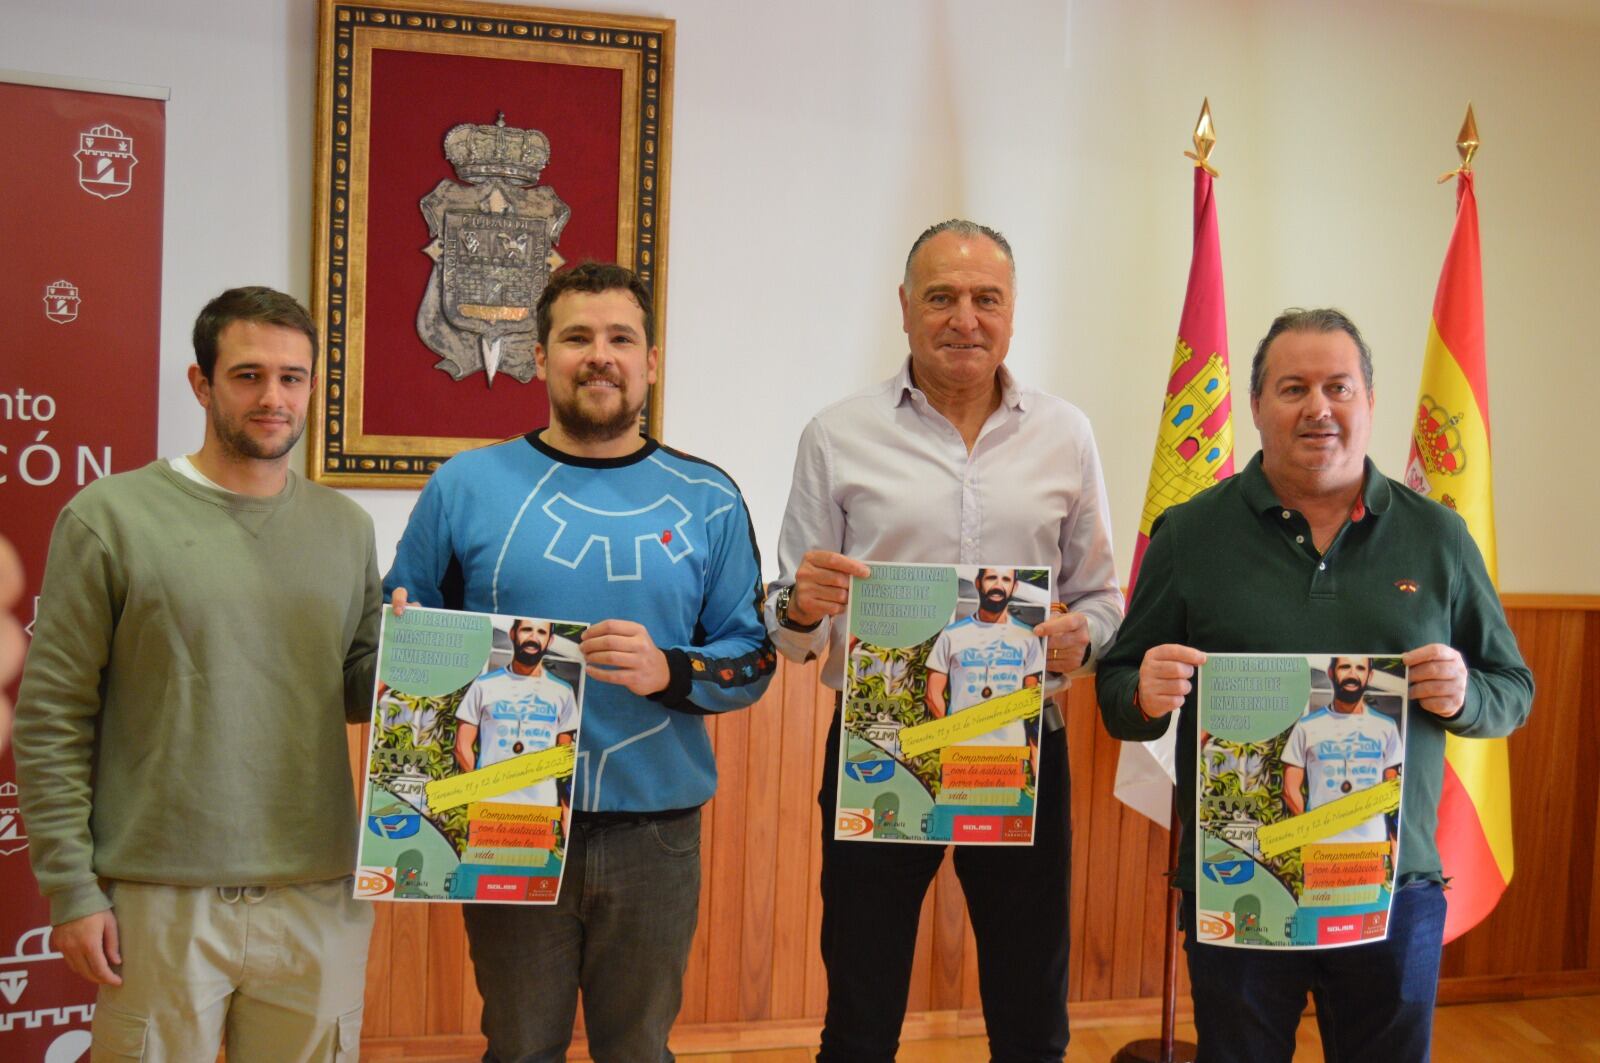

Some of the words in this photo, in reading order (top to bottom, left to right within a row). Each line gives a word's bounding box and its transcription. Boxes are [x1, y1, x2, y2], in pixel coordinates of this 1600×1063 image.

[0, 388, 57, 421] nto
[889, 567, 949, 582] REGIONAL
[913, 585, 930, 600] DE
[860, 601, 920, 619] INVIERNO
[921, 605, 937, 619] DE
[423, 612, 484, 631] REGIONAL
[447, 632, 464, 648] DE
[391, 647, 451, 667] INVIERNO
[453, 652, 469, 669] DE
[952, 752, 1018, 764] Comprometidos
[950, 767, 966, 775] con
[968, 765, 978, 774] la
[948, 779, 972, 789] para
[974, 778, 993, 787] toda
[995, 779, 1005, 787] la
[948, 791, 968, 801] vida
[480, 808, 548, 823] Comprometidos
[479, 825, 494, 833] con
[496, 823, 506, 833] la
[475, 839, 499, 848] para
[501, 838, 521, 847] toda
[523, 839, 534, 847] la
[474, 850, 495, 860] vida
[1313, 849, 1379, 862] Comprometidos
[1313, 866, 1329, 874] con
[1331, 863, 1340, 874] la
[1311, 880, 1335, 889] para
[1337, 878, 1356, 887] toda
[1358, 877, 1367, 886] la
[1312, 891, 1331, 902] vida
